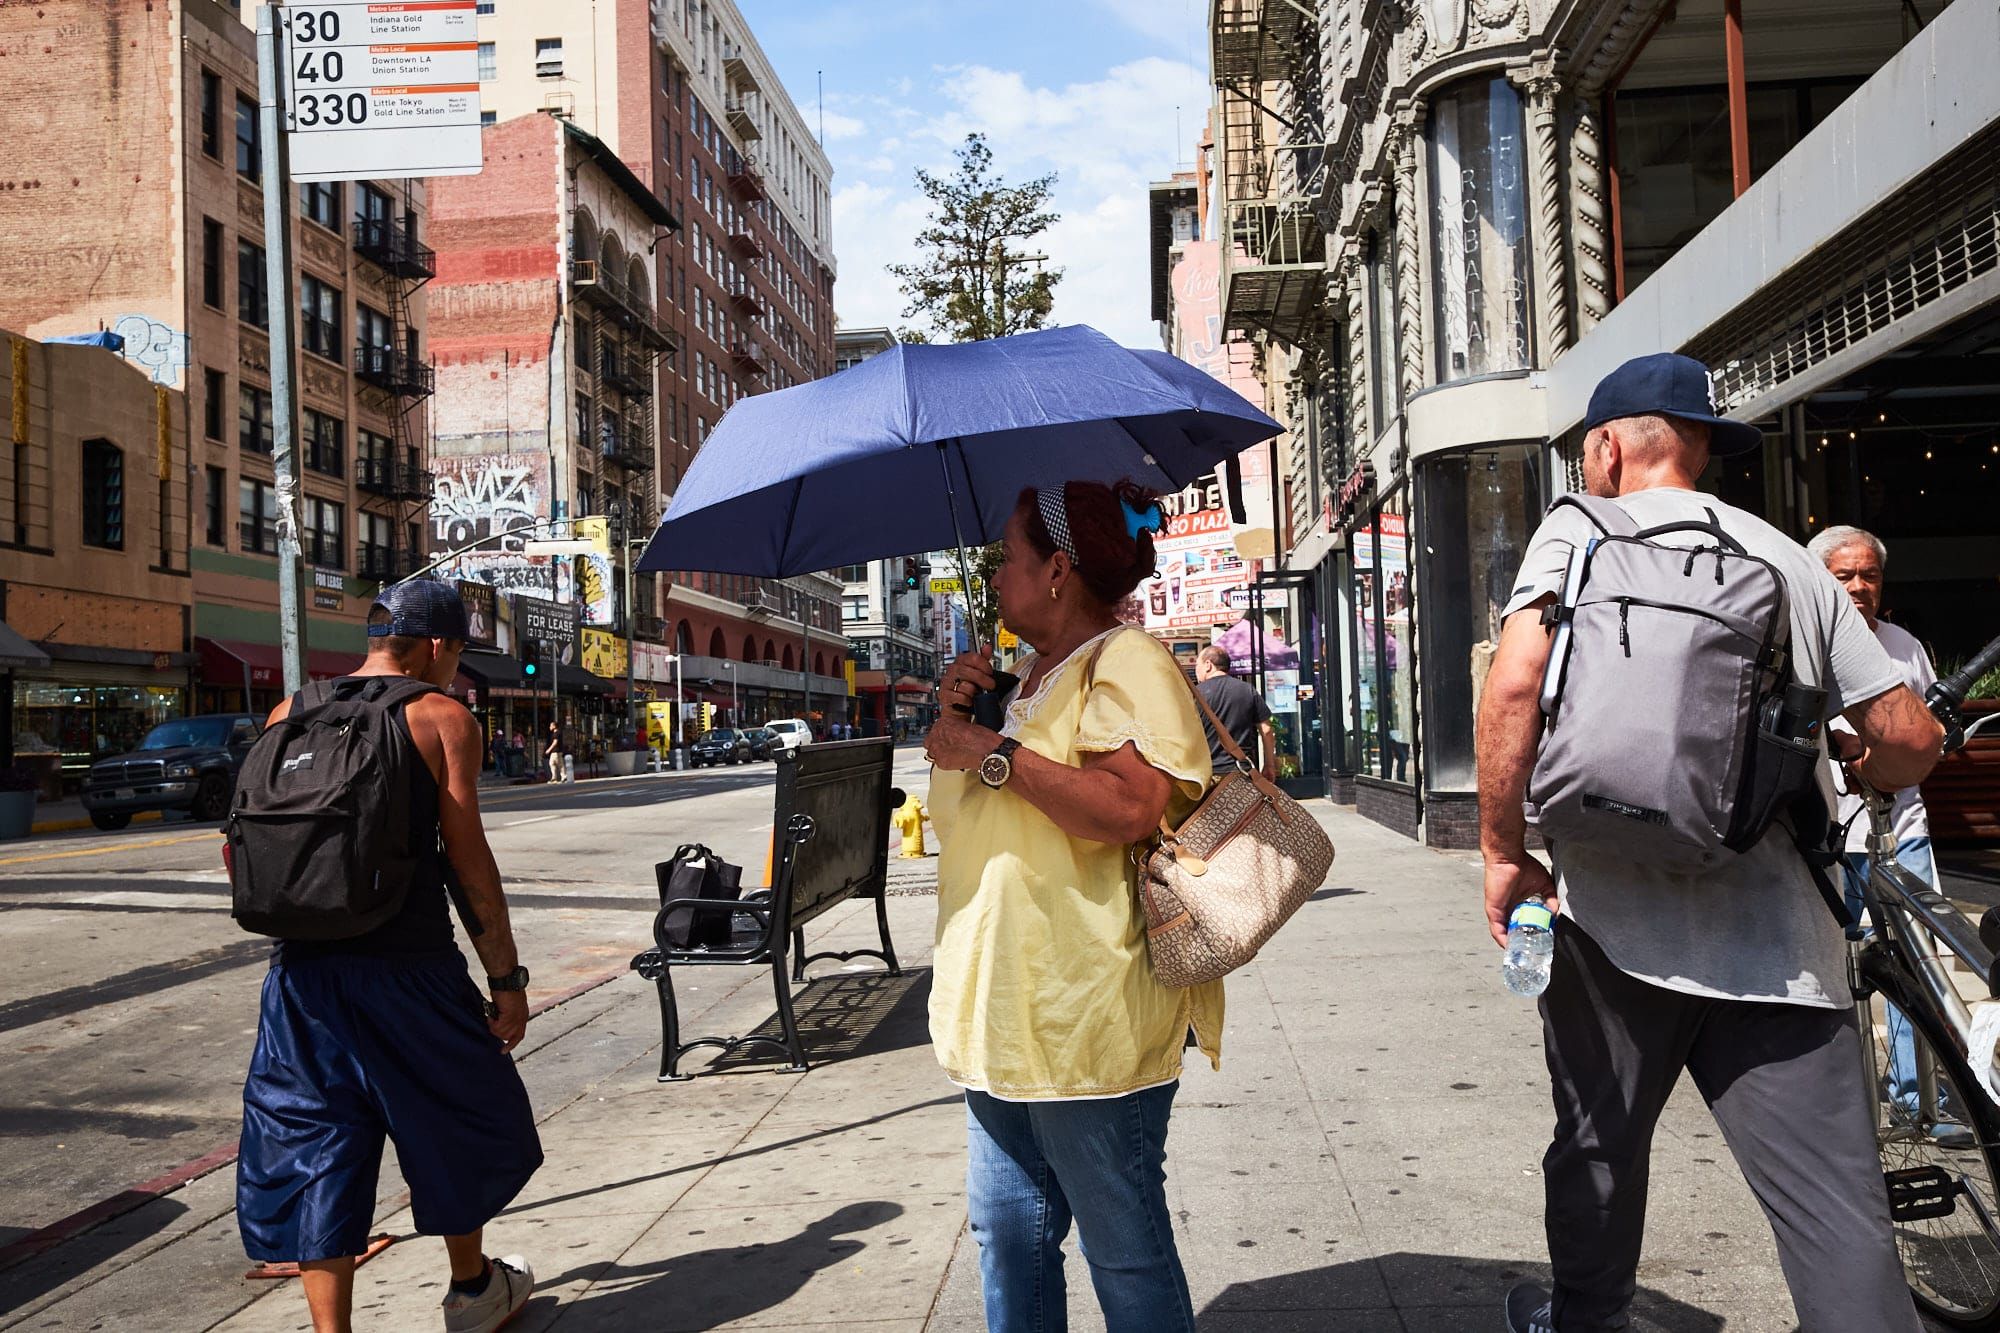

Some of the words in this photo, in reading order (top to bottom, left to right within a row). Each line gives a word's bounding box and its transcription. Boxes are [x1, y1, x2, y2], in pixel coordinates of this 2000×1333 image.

[295, 10, 340, 42] 30
[370, 16, 400, 24] Indiana
[391, 25, 420, 33] Station
[372, 56, 417, 65] Downtown
[297, 51, 343, 83] 40
[372, 66, 396, 74] Union
[399, 65, 430, 74] Station
[373, 99, 396, 107] Little
[399, 98, 423, 107] Tokyo
[299, 92, 367, 126] 330
[396, 108, 413, 116] Line
[416, 107, 445, 115] Station
[1459, 168, 1484, 343] ROBATA
[316, 572, 327, 587] FOR
[327, 574, 344, 590] LEASE
[934, 581, 951, 590] PED
[527, 614, 545, 627] FOR
[548, 617, 574, 632] LEASE
[527, 628, 544, 640] (213)
[545, 631, 575, 643] 304-4727
